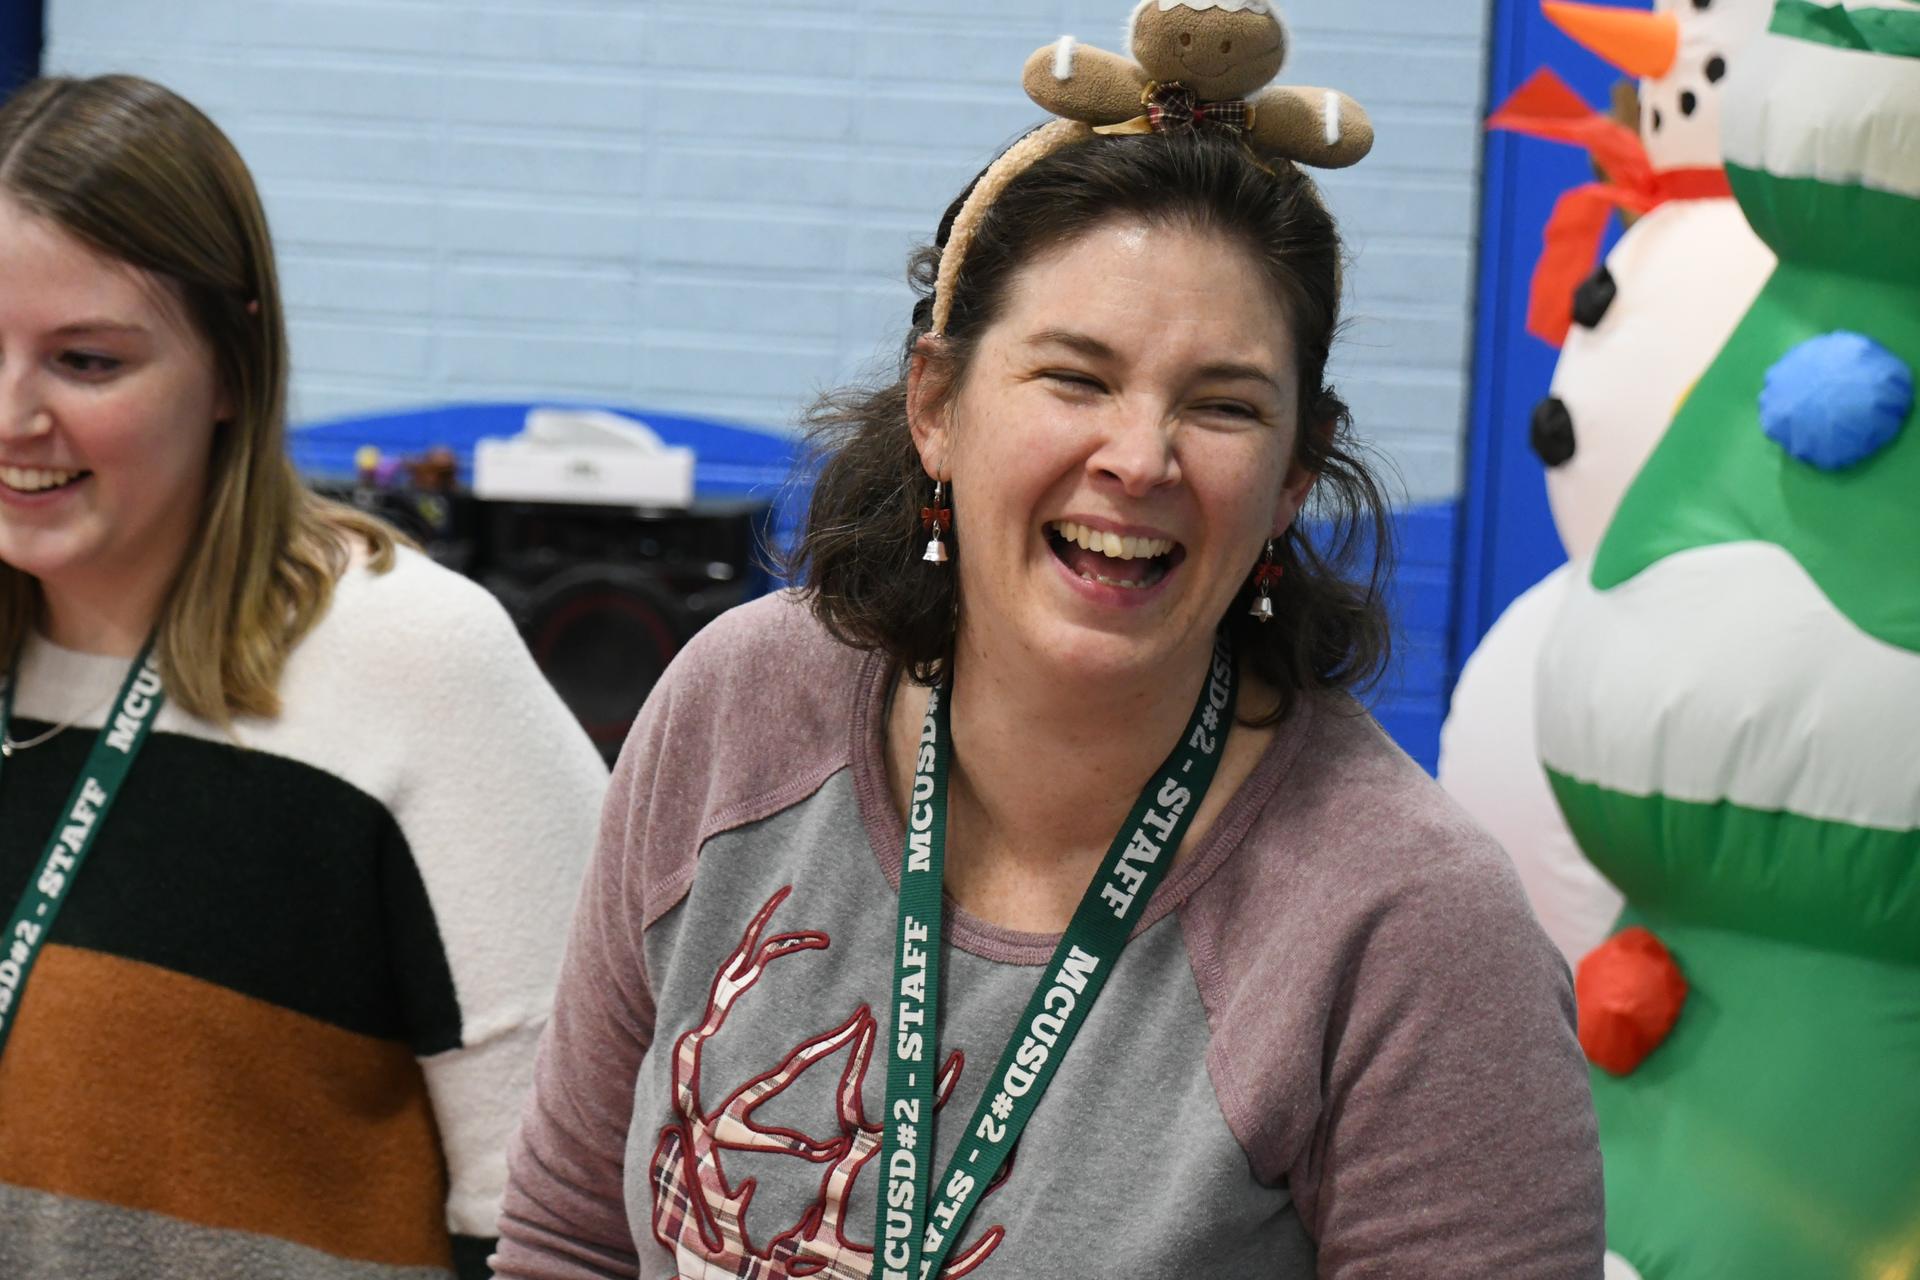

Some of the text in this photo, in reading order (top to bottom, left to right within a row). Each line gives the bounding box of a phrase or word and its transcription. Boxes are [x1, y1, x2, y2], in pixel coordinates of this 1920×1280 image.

[1188, 638, 1231, 754] USD#2
[908, 683, 942, 872] MCUSD#
[1182, 759, 1193, 772] -
[38, 777, 106, 899] STAFF
[1100, 777, 1191, 919] STAFF
[36, 902, 47, 917] -
[0, 919, 41, 1031] SD#2
[897, 916, 928, 1061] STAFF
[976, 945, 1099, 1143] MCUSD#2
[969, 1149, 979, 1162] -
